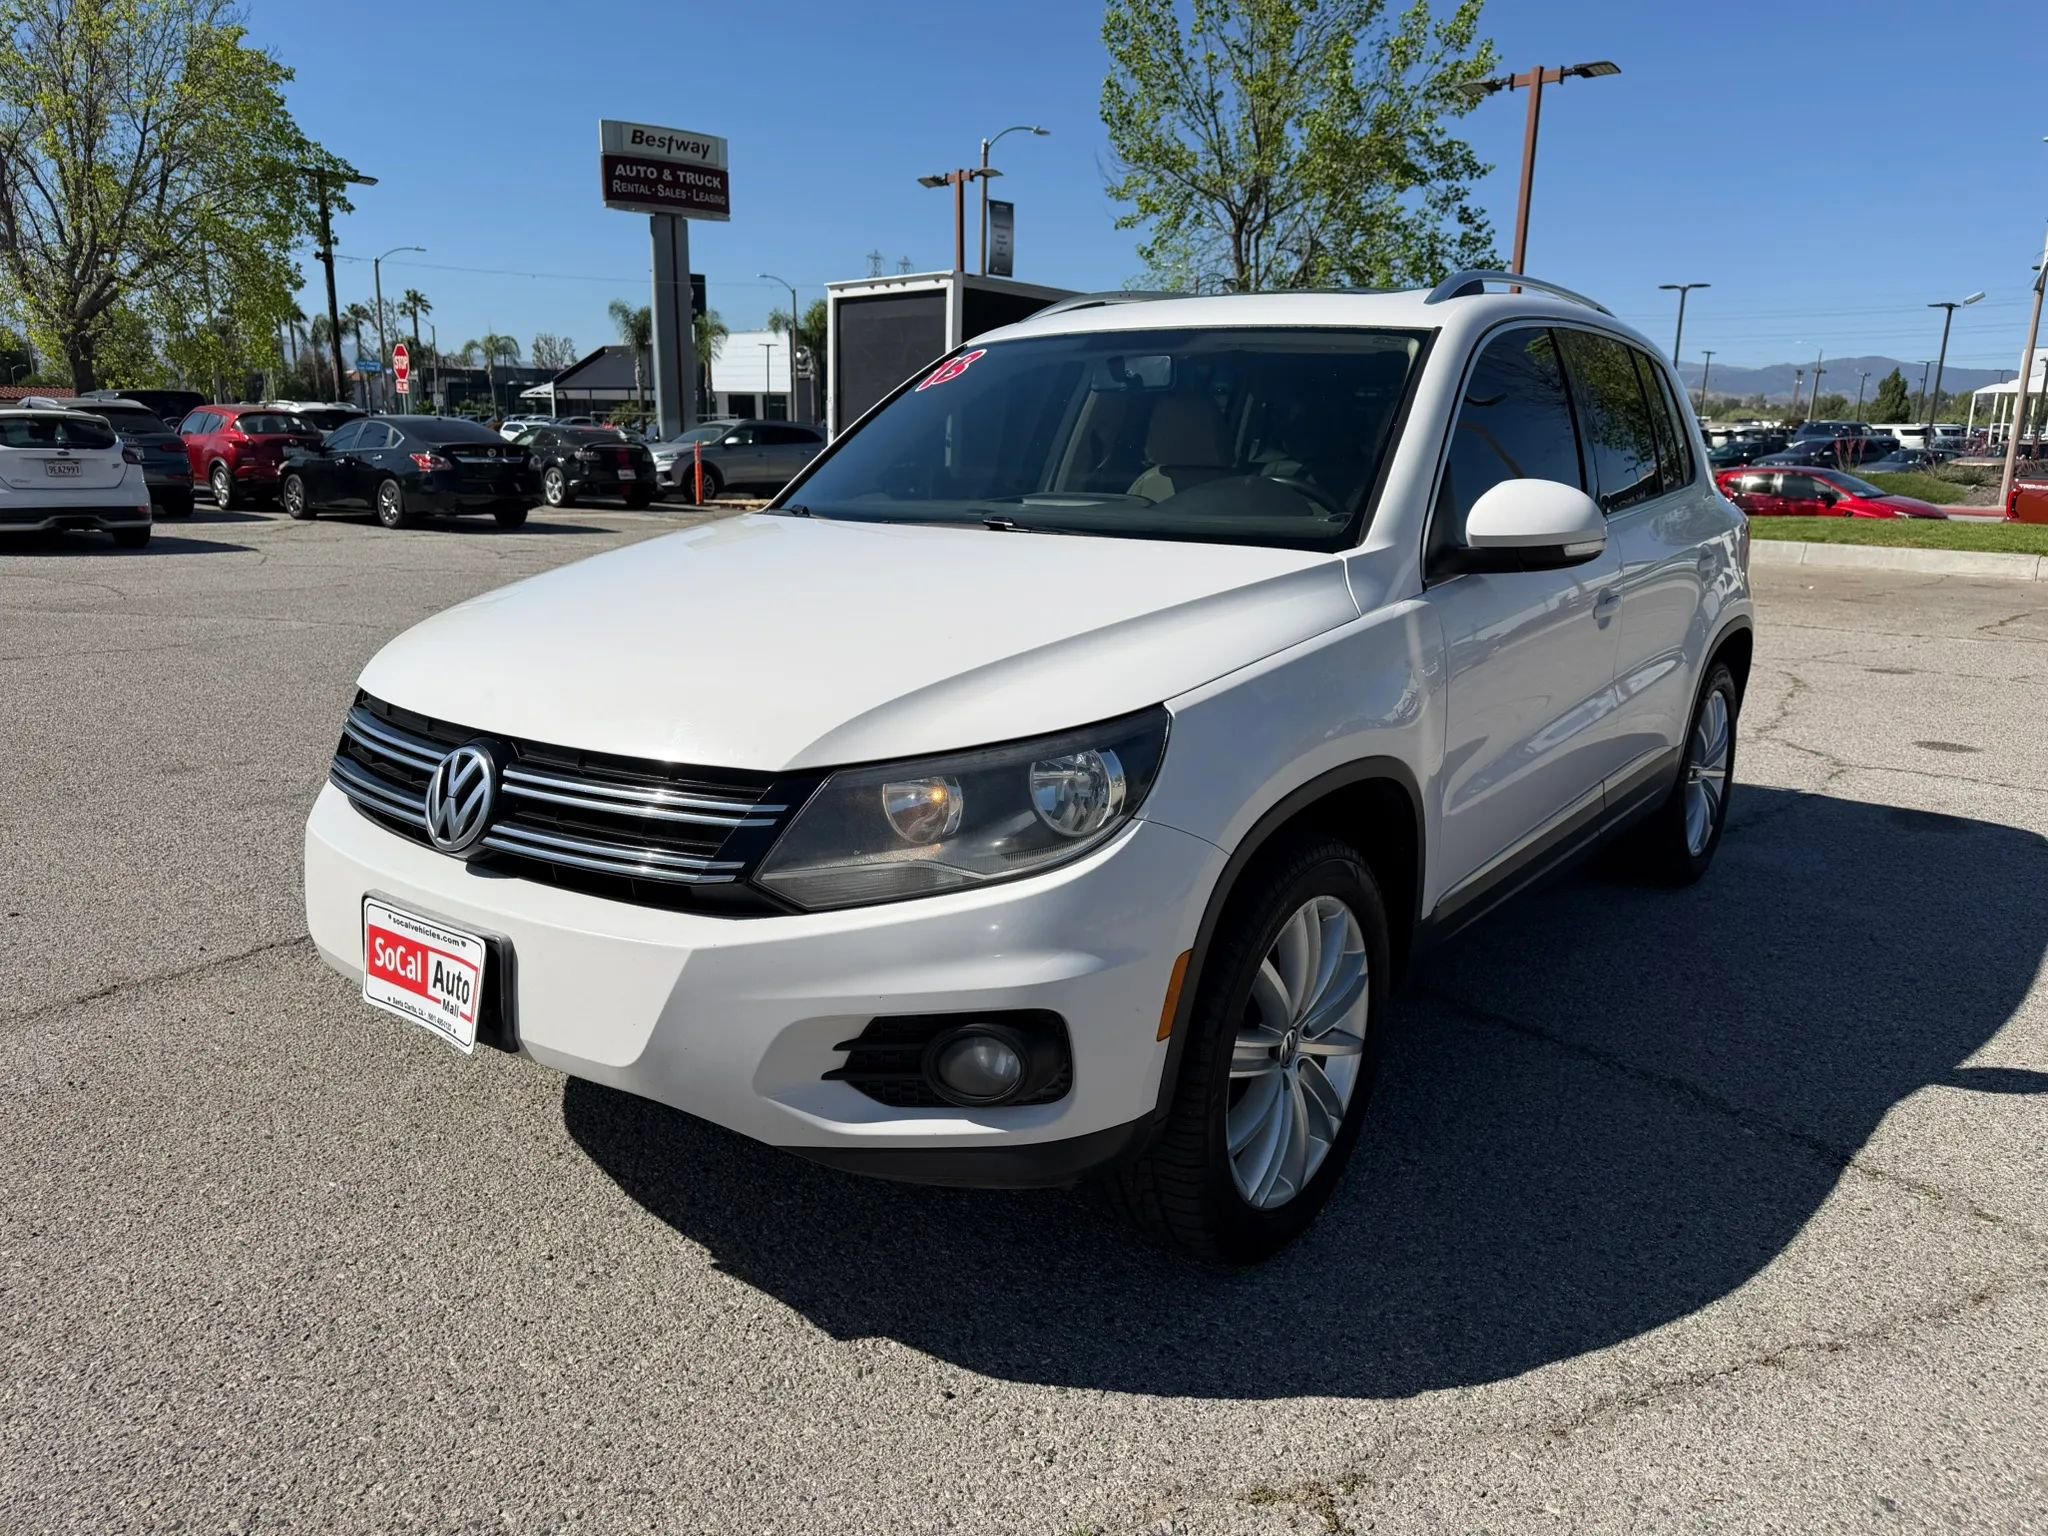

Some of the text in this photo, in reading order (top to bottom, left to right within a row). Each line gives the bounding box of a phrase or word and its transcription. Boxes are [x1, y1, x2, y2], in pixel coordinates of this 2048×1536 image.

[631, 129, 710, 159] Bestway
[612, 180, 652, 195] RENTAL
[657, 184, 686, 199] SALES
[615, 164, 721, 189] AUTO & TRUCK
[394, 355, 408, 369] STOP
[393, 916, 460, 947] socalvehicles.com
[374, 937, 422, 983] SoCal
[432, 960, 470, 1005] Auto
[442, 998, 459, 1018] Mall
